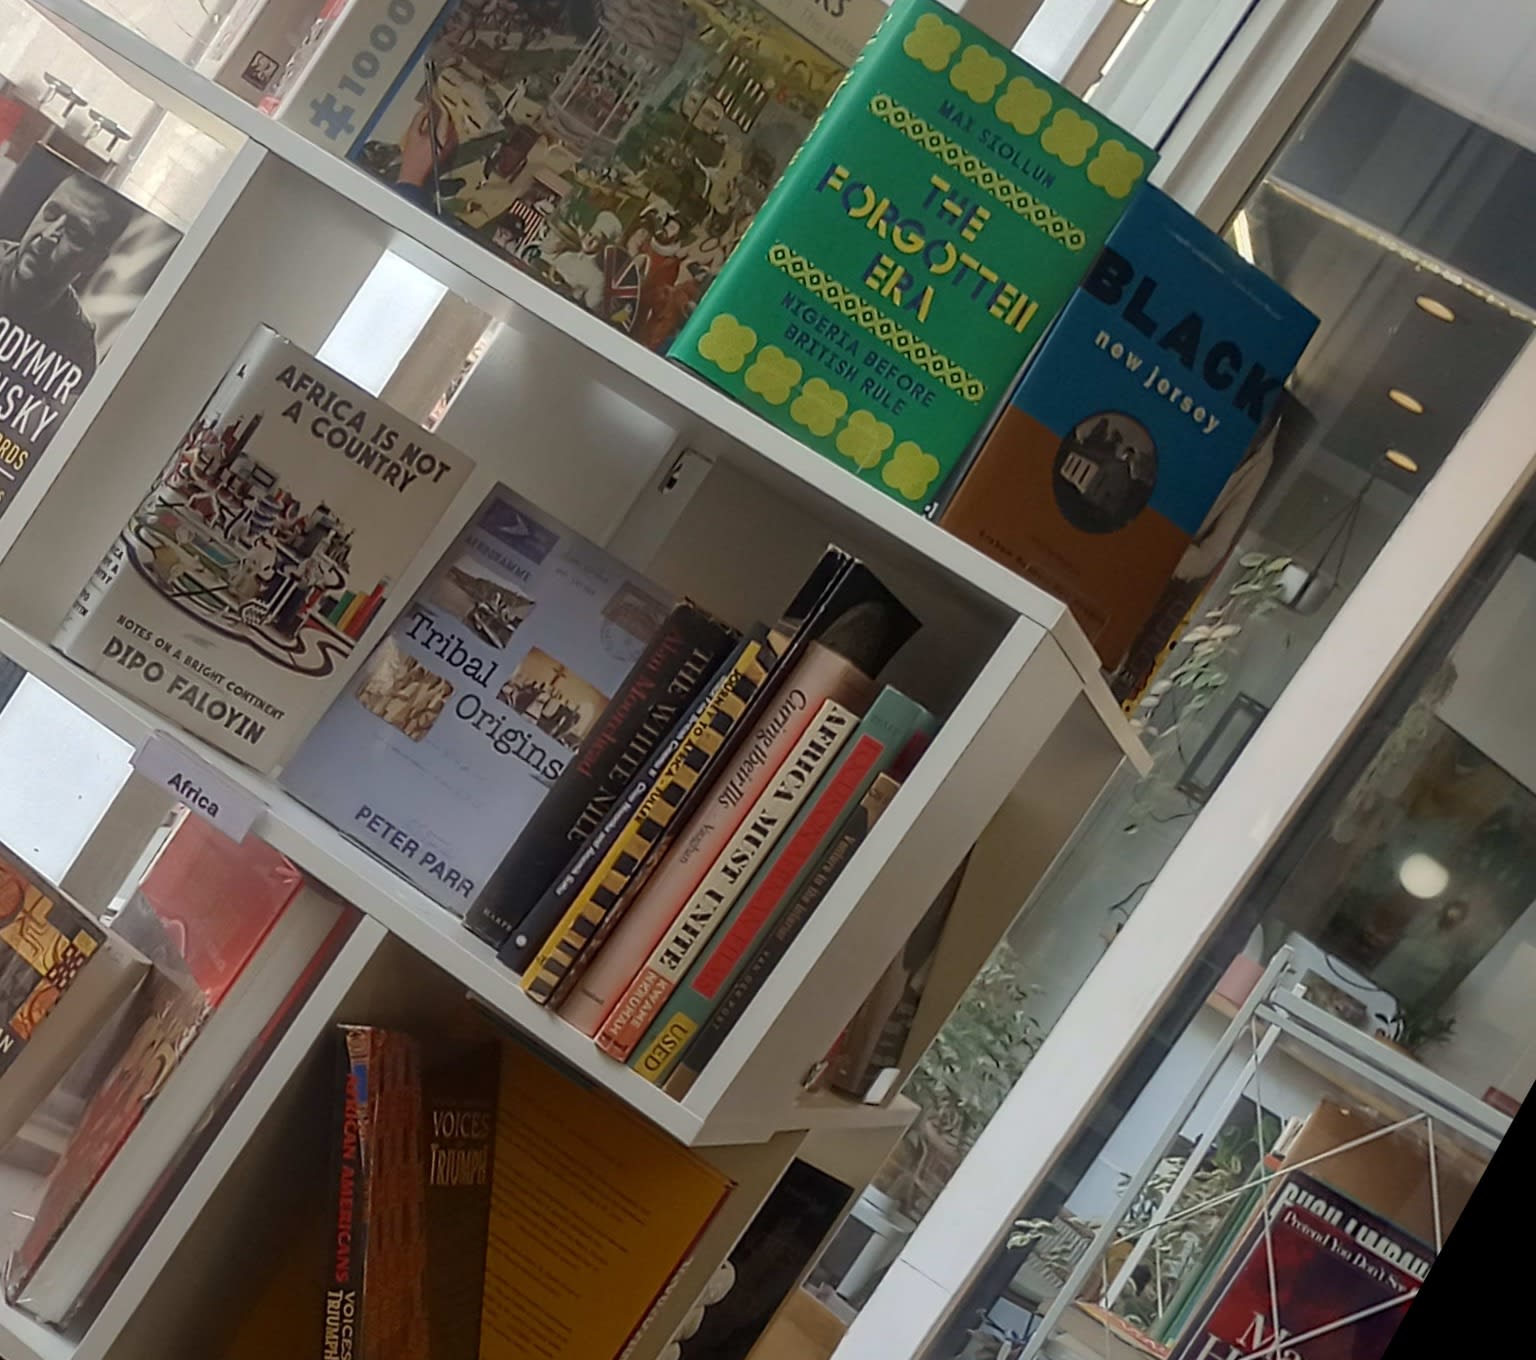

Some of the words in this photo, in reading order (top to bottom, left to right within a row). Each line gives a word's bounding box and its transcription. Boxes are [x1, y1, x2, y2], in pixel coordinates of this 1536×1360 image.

[977, 126, 1057, 190] SIOLLUN
[816, 162, 1039, 333] FORGOTTEN
[917, 174, 991, 244] THE
[861, 250, 938, 324] ERA
[779, 290, 861, 357] NIGERIA
[861, 349, 937, 409] BEFORE
[781, 322, 859, 385] BRITISH
[858, 375, 908, 417] RULE
[1080, 243, 1286, 424] BLACK
[1093, 327, 1144, 374] new
[1143, 366, 1222, 438] jersey
[275, 362, 369, 434] AFRICA
[370, 423, 399, 453] IS
[399, 441, 450, 486] NOT
[281, 401, 304, 426] A
[307, 414, 417, 495] COUNTRY
[116, 614, 153, 643] NOTES
[183, 654, 225, 687] BRIGHT
[225, 680, 285, 722] CONTINENT
[404, 611, 499, 688] Tribal
[665, 648, 711, 700] THE
[101, 635, 167, 687] DIPO
[164, 673, 266, 746] FALOYIN
[757, 687, 809, 747] Curing
[449, 690, 567, 784] Origins
[605, 699, 675, 786] WHITE
[651, 739, 678, 770] Cinema
[771, 706, 848, 804] AFRICA
[165, 771, 223, 818] Africa
[565, 786, 616, 846] NILE
[353, 805, 421, 859] PETER
[418, 848, 476, 898] PARR
[718, 807, 778, 884] MUST
[821, 834, 855, 874] Venture
[657, 887, 723, 971] UNITE
[608, 970, 657, 1035] NKRUMAH
[628, 979, 668, 1027] KWAME
[640, 1022, 687, 1072] USED
[339, 1075, 362, 1160] AFRICAN
[434, 1110, 492, 1137] VOICES
[332, 1168, 357, 1280] AMERICANS
[1282, 1210, 1330, 1246] Pretend
[1330, 1237, 1352, 1261] You
[1352, 1253, 1386, 1282] Don't
